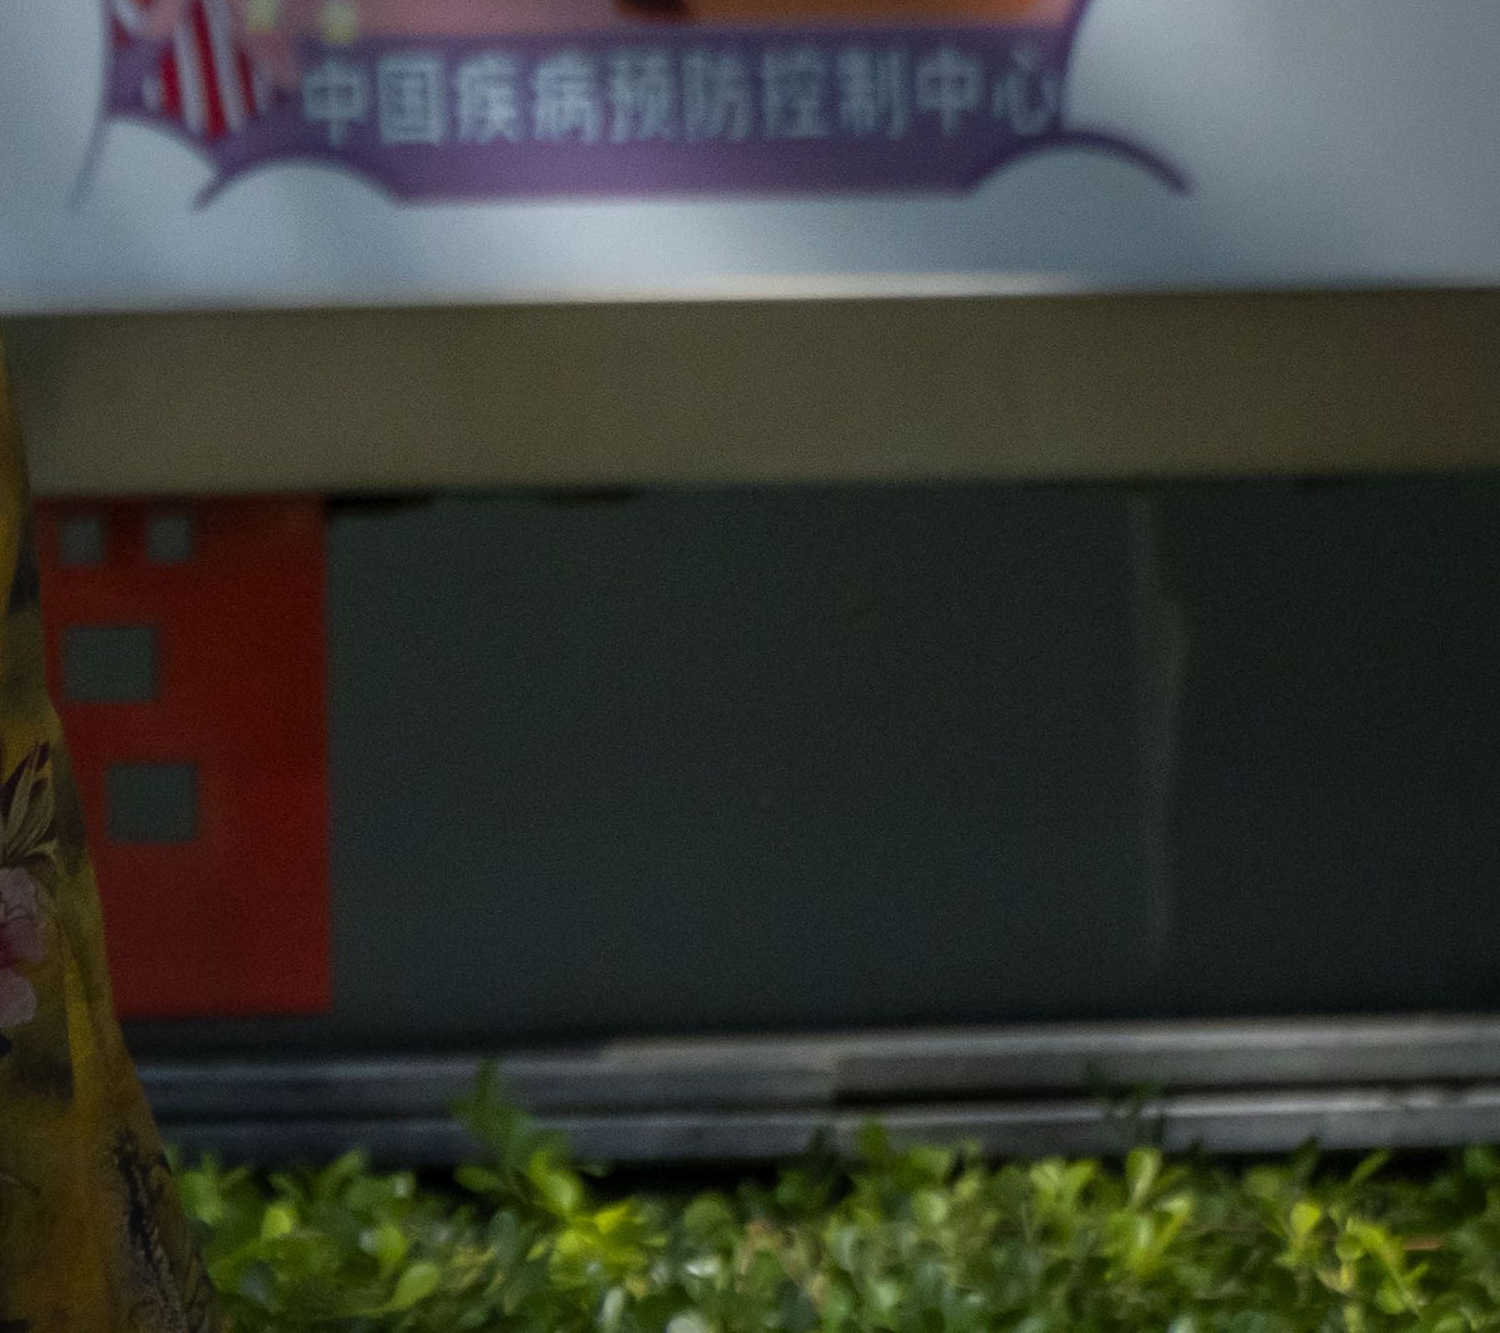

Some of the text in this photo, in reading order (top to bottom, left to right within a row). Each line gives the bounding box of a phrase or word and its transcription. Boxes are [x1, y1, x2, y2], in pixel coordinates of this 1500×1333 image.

[303, 40, 1062, 147] 中国疾病预防控制中心
